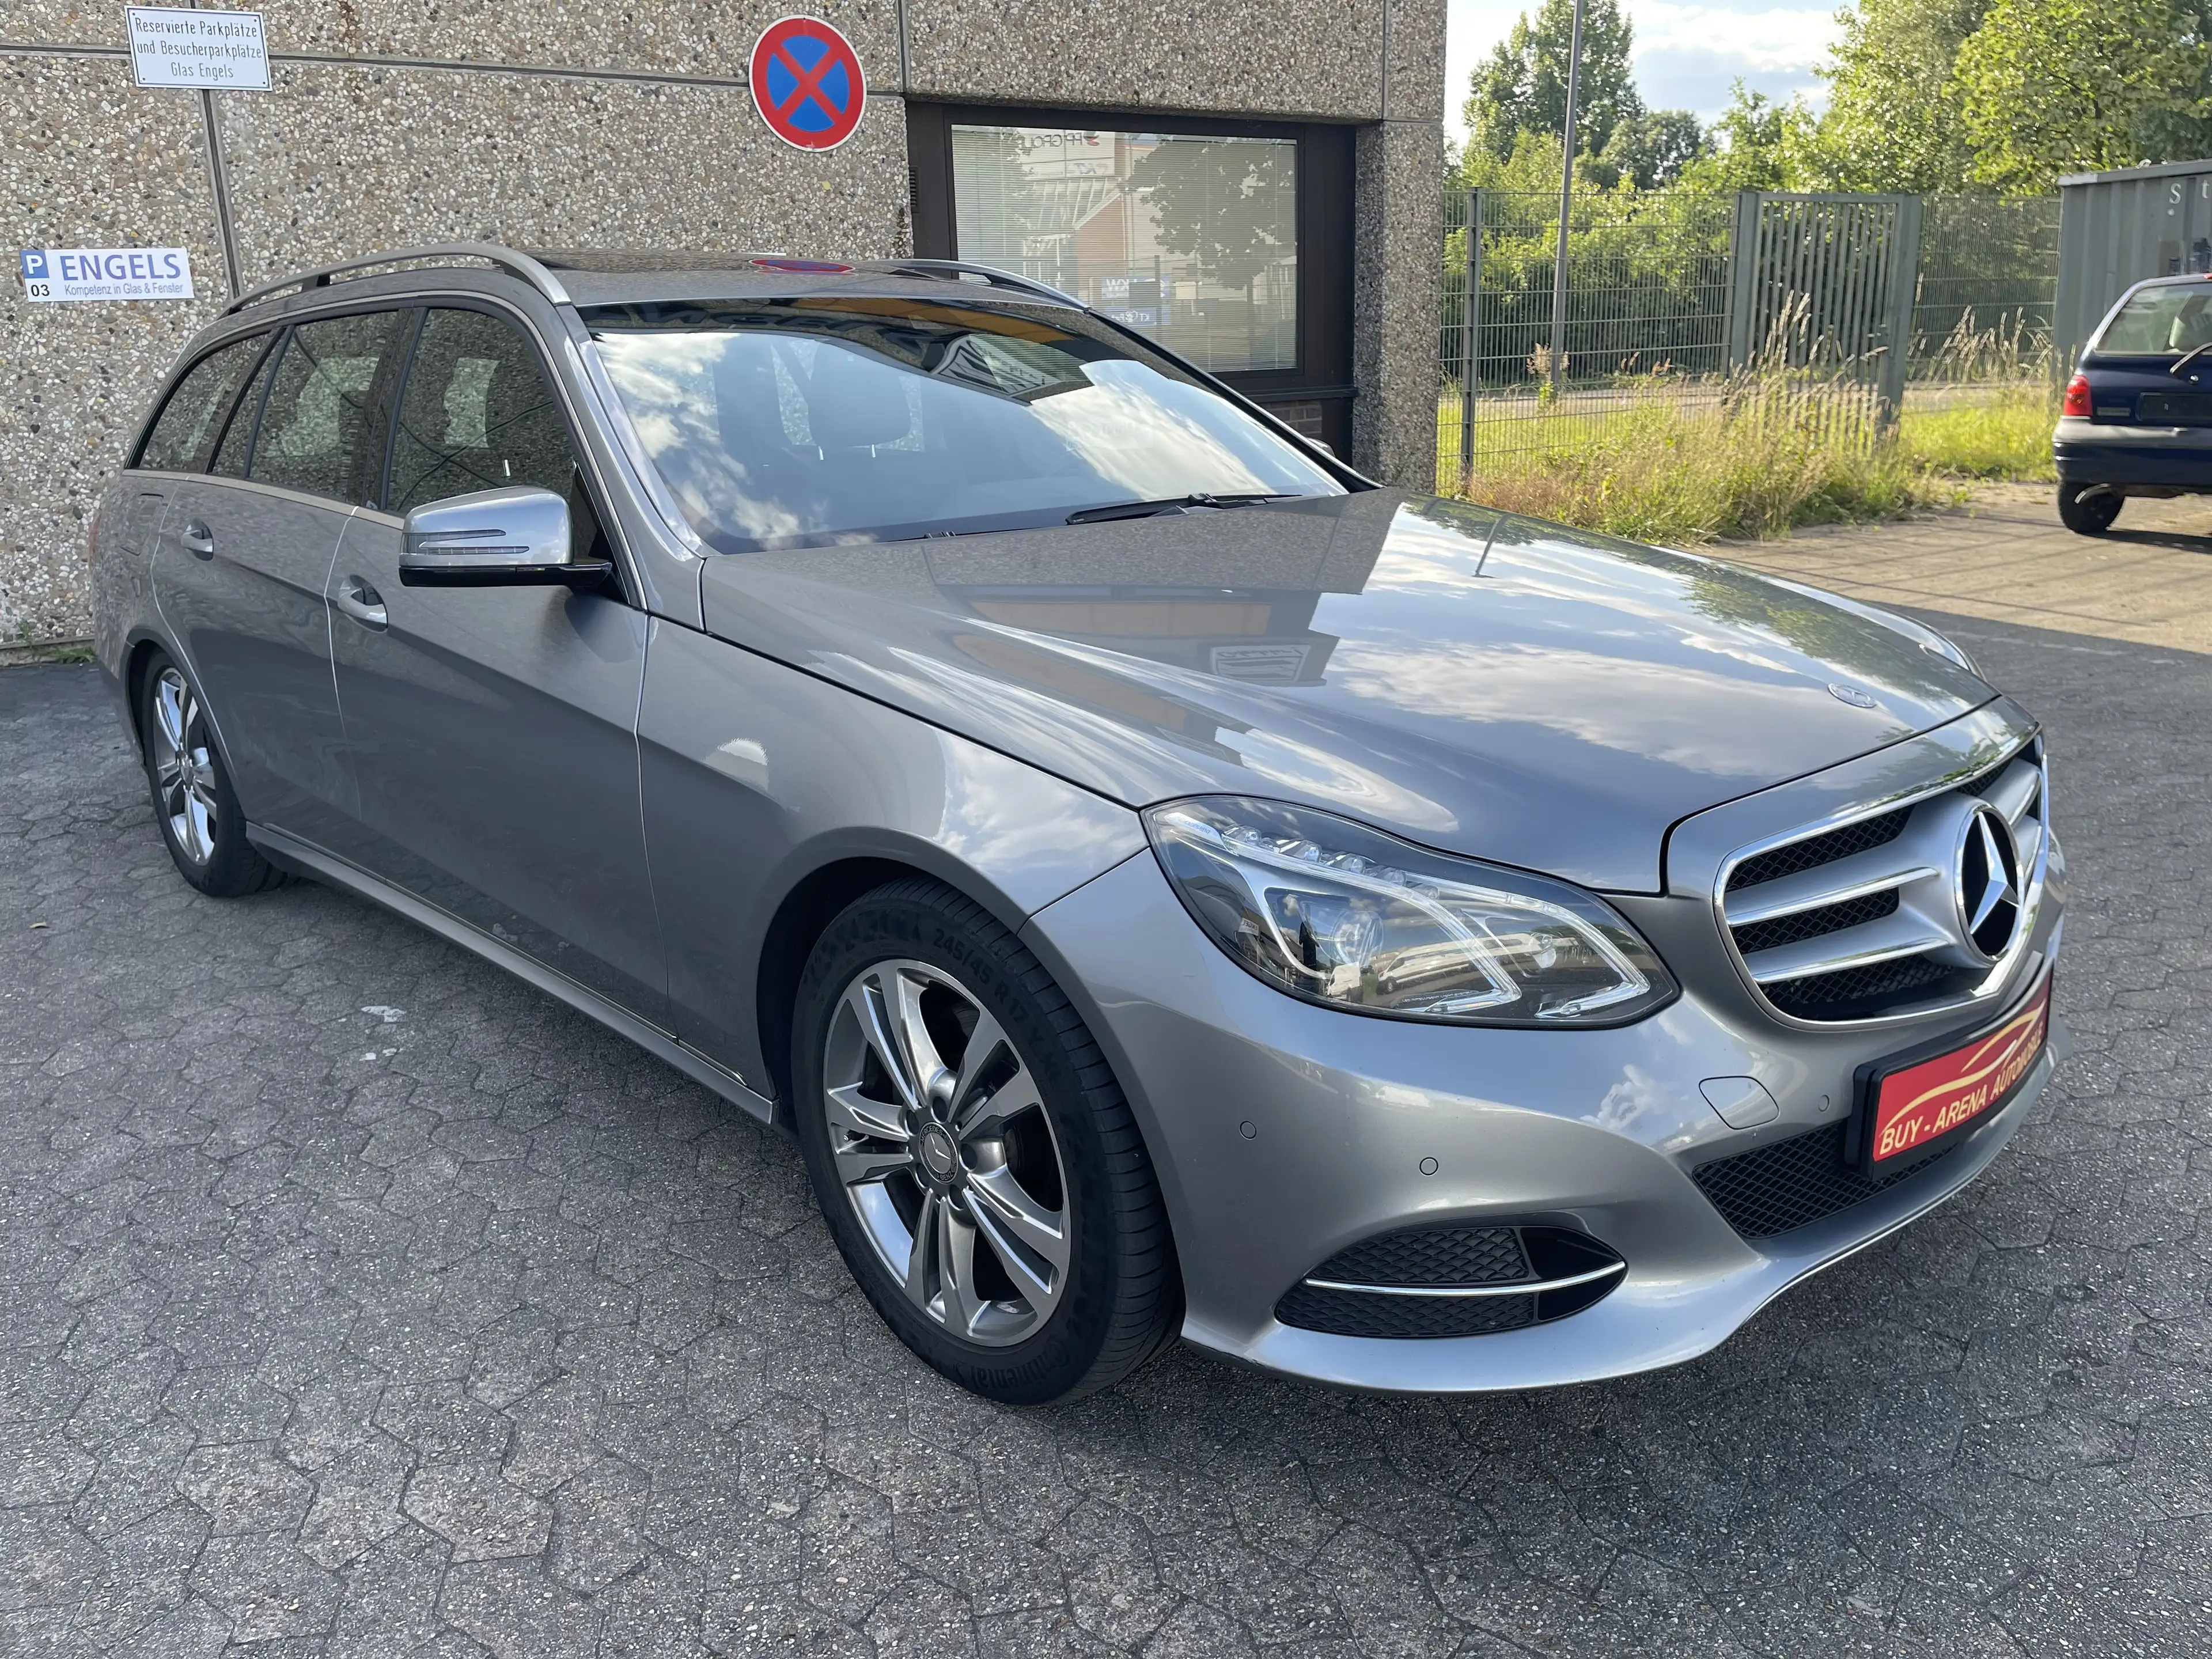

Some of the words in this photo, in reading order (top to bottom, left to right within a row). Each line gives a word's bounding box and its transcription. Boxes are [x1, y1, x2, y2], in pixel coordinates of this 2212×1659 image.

[135, 17, 196, 35] Reservierte
[199, 21, 257, 40] Parkplätze
[137, 40, 156, 55] und
[161, 40, 262, 60] Besucherparkplätze
[171, 62, 194, 77] Glas
[199, 63, 234, 81] Engels
[25, 255, 44, 275] P
[60, 253, 181, 281] ENGELS
[31, 284, 50, 297] 03
[65, 284, 112, 297] Kompetenz
[113, 284, 122, 295] in
[123, 283, 142, 294] Glas
[144, 283, 151, 294] &
[153, 283, 184, 294] Fenster
[933, 927, 995, 984] 245/45
[1880, 1116, 1924, 1155] BUY
[1933, 1084, 1988, 1133] ARENA
[921, 1125, 944, 1143] MERCEDES
[940, 1170, 954, 1181] BENZ
